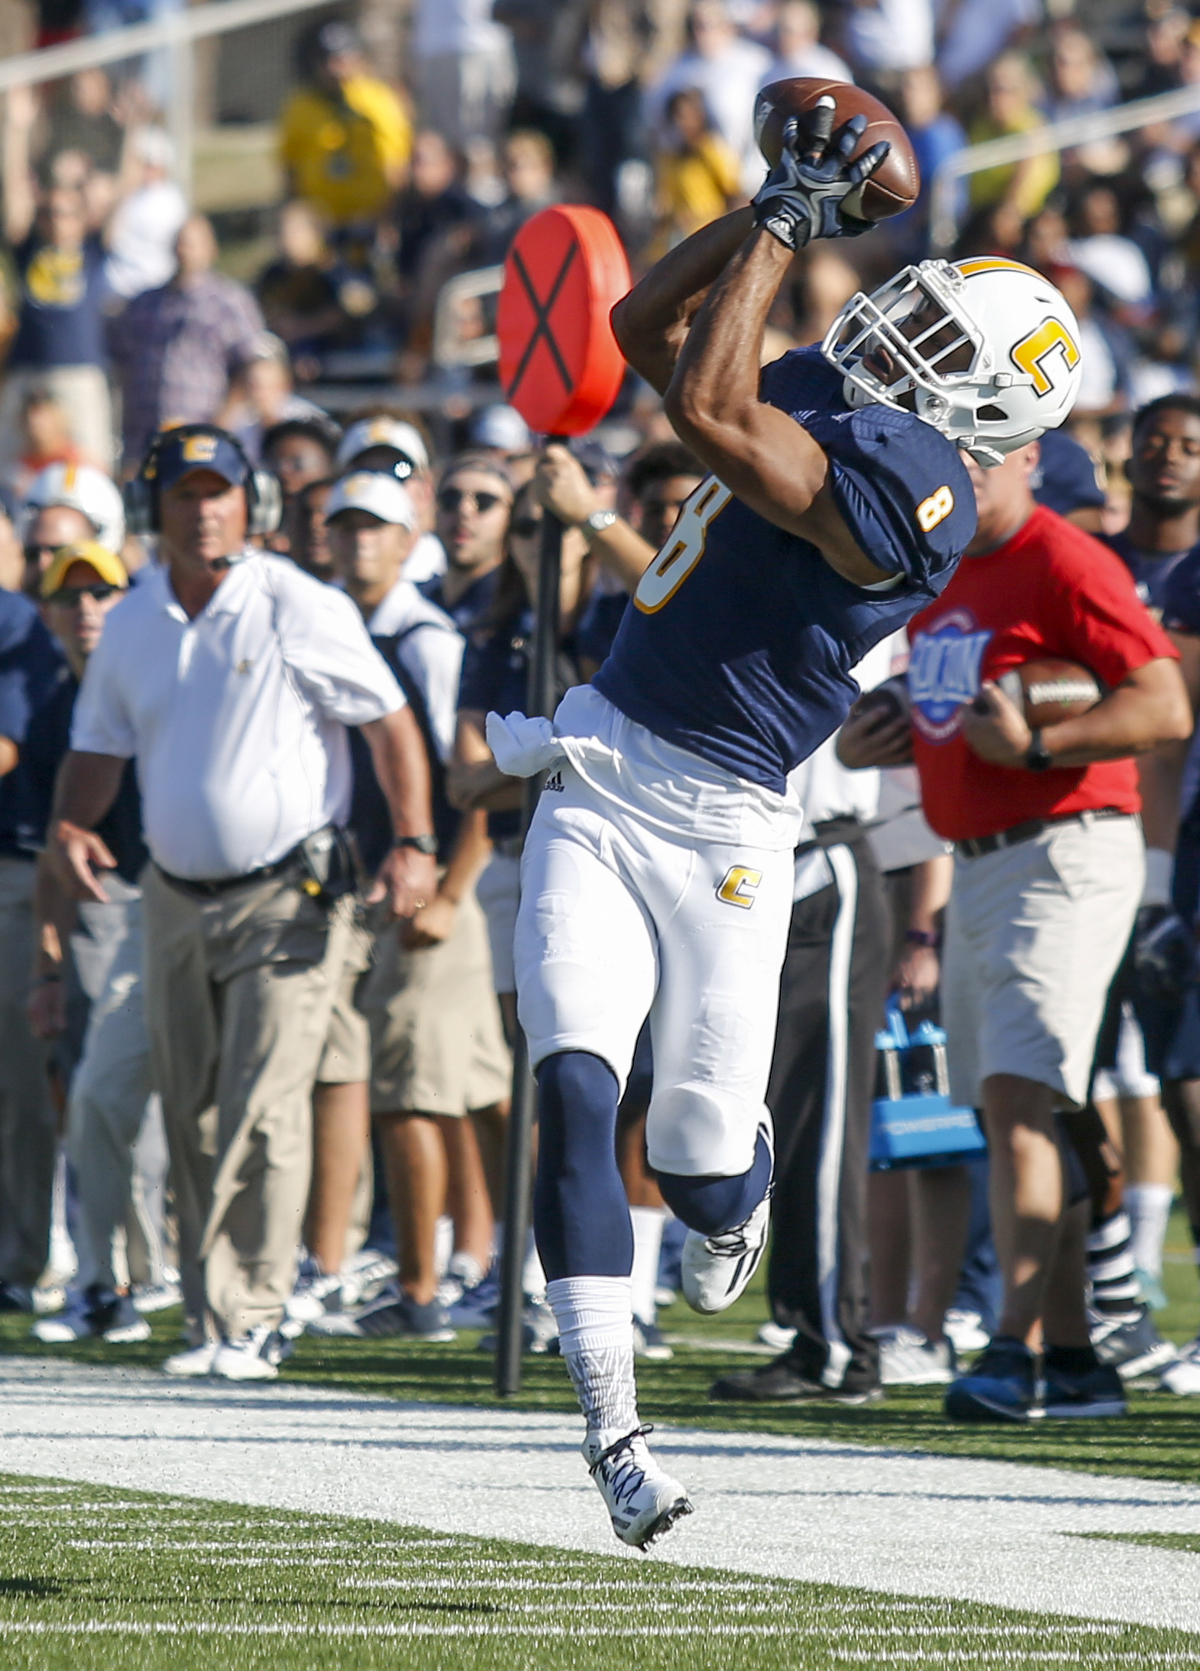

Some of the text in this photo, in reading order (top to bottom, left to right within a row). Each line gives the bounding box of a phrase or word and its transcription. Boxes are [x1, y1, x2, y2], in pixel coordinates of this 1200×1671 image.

[1009, 315, 1081, 398] C
[915, 485, 955, 533] 8
[634, 474, 735, 615] 8
[716, 864, 763, 909] C
